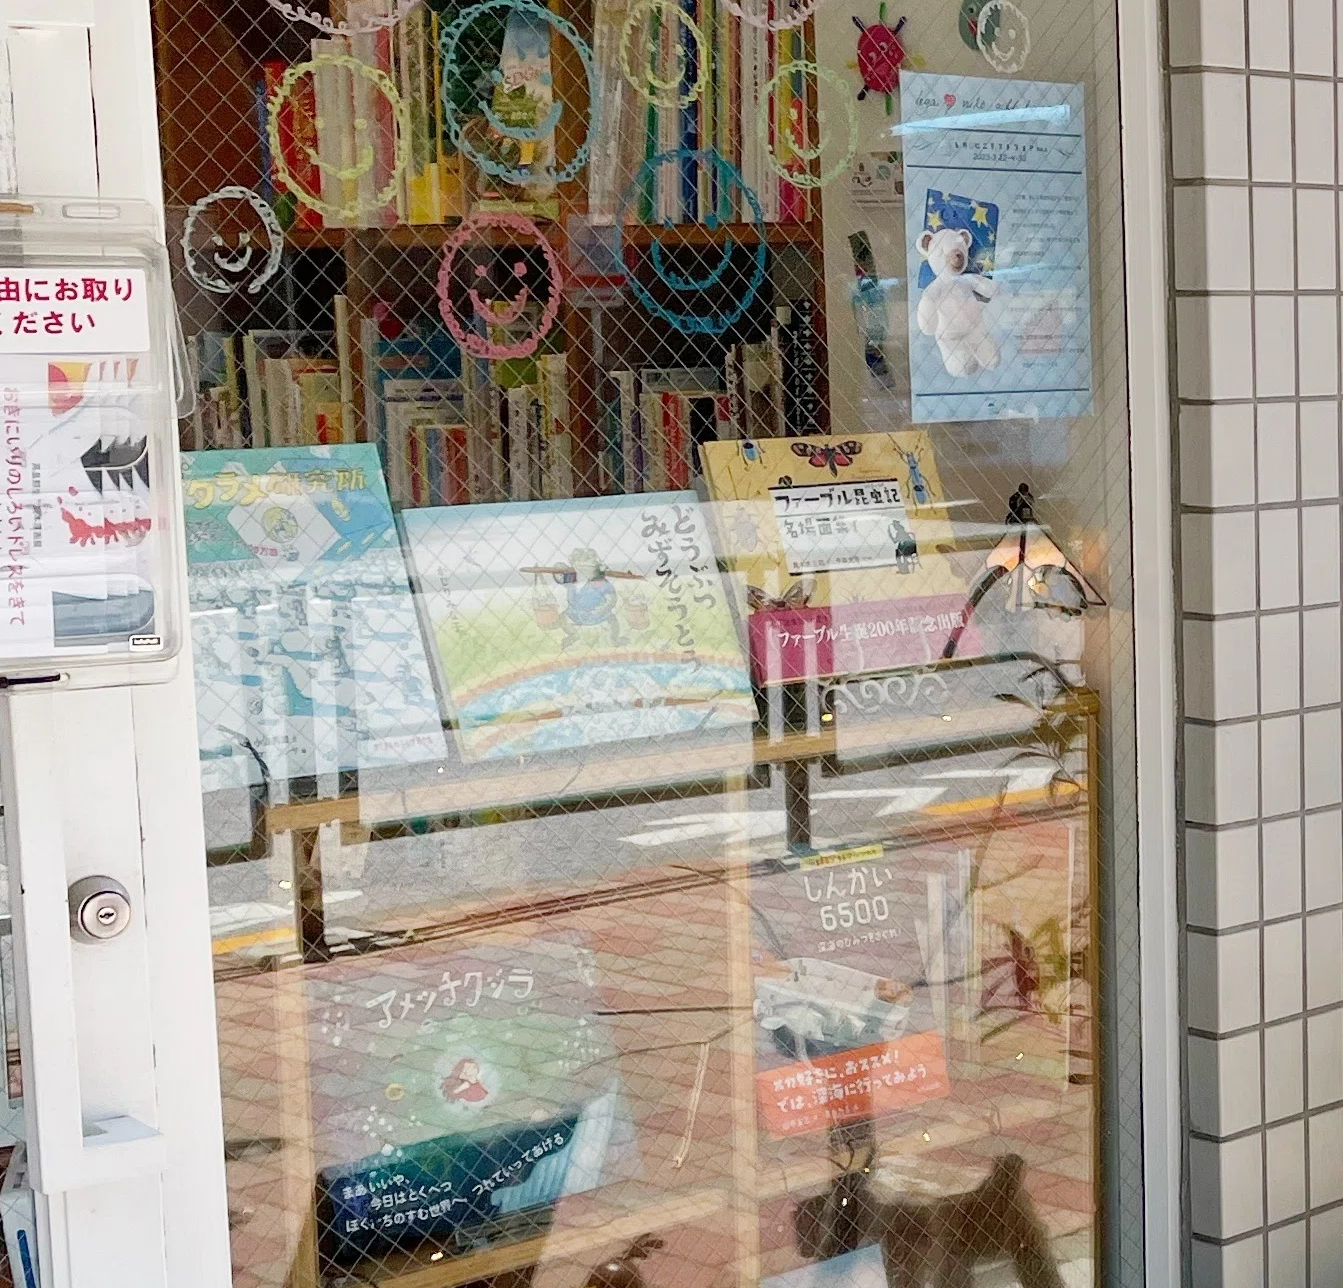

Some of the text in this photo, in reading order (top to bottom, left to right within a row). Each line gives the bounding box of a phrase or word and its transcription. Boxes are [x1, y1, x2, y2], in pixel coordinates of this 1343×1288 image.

[0, 276, 133, 303] 由にお取り
[0, 311, 95, 336] ださい
[774, 487, 901, 512] ファーブル昆虫記
[803, 866, 893, 902] しんかい
[820, 895, 889, 931] 6500
